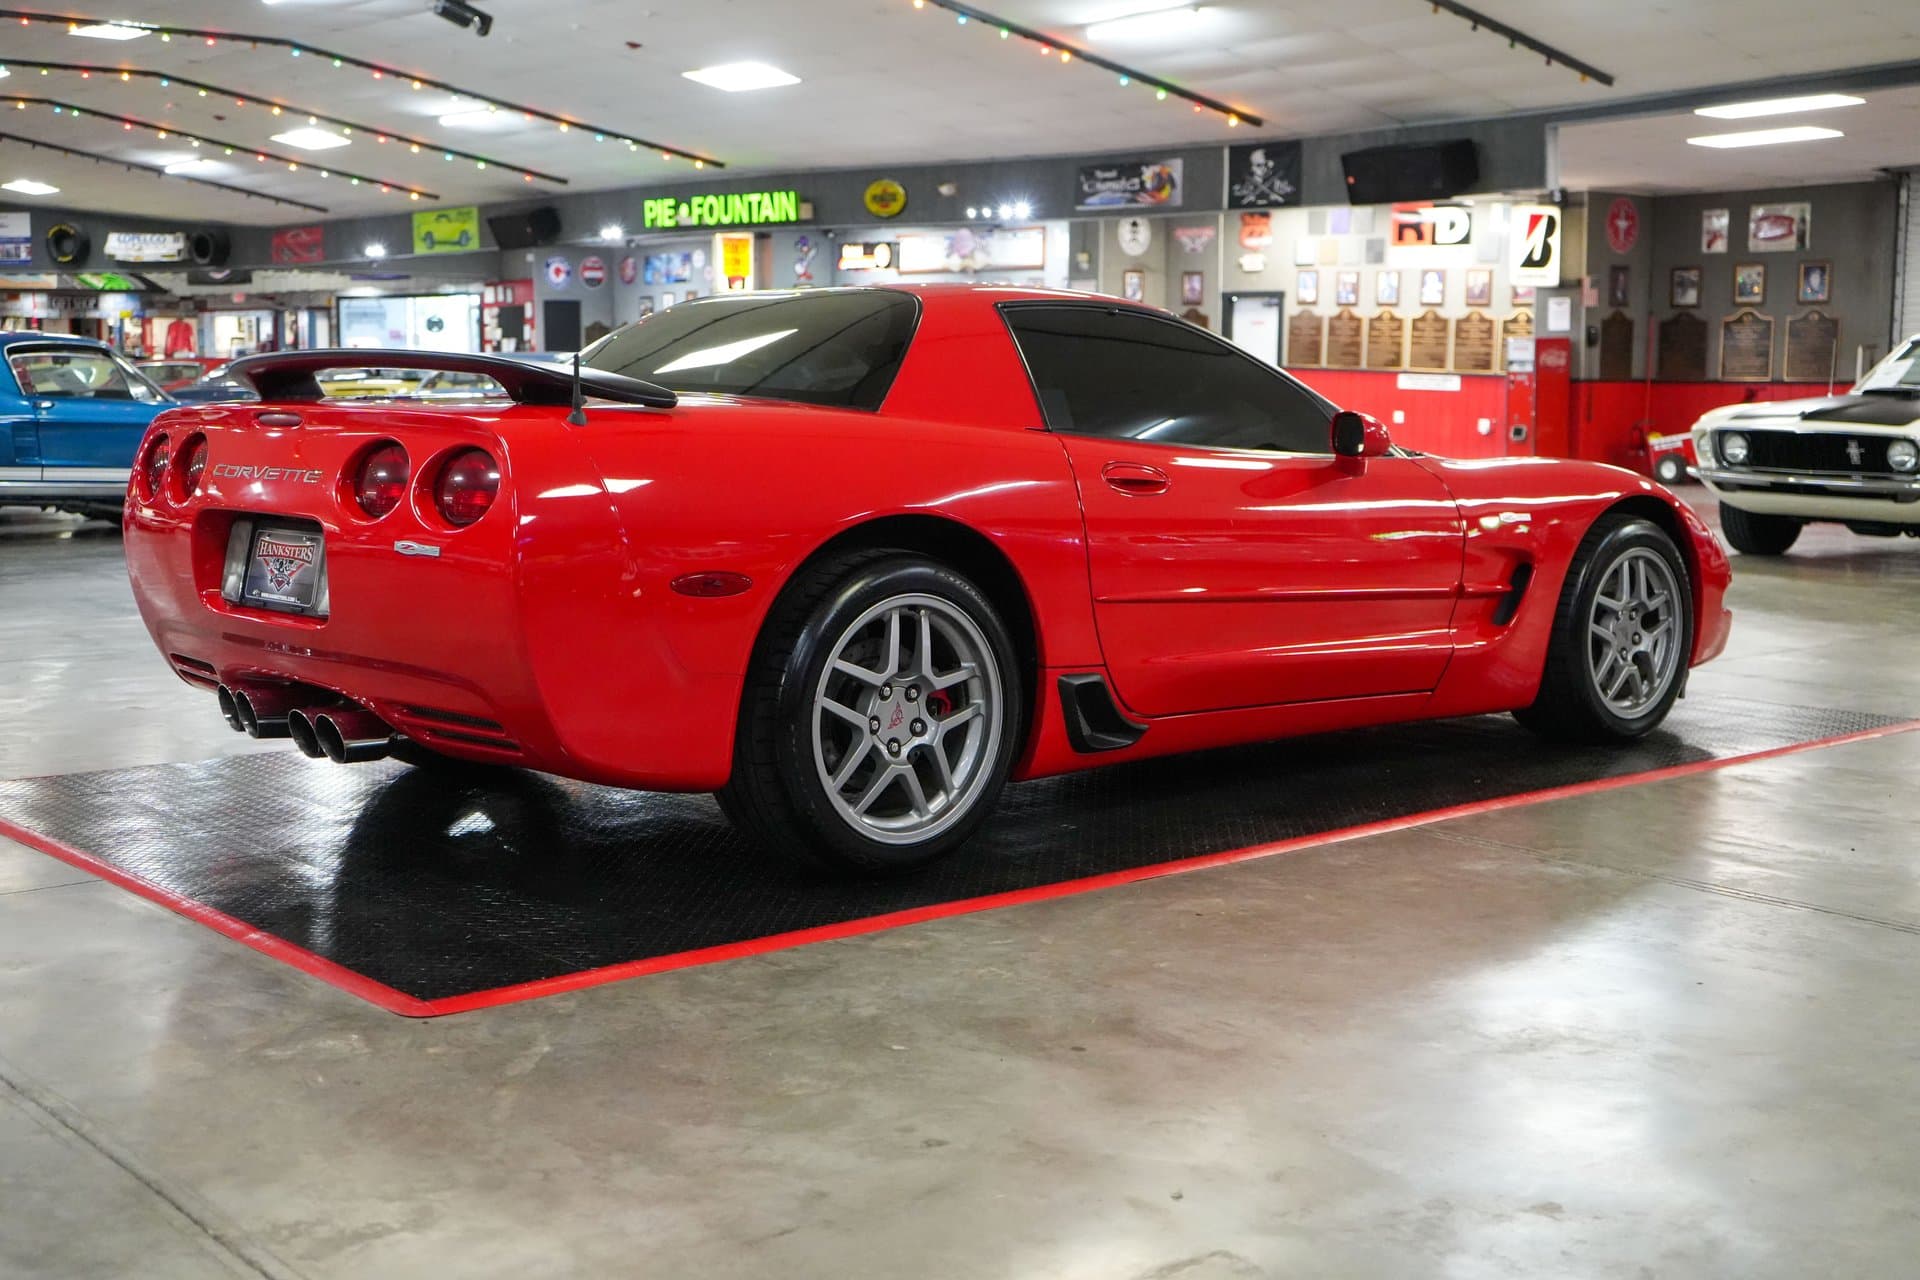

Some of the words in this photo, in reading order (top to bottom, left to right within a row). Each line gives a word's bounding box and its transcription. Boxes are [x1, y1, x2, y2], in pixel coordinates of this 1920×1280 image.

[643, 199, 677, 228] PIE
[690, 190, 797, 226] FOUNTAIN
[212, 463, 324, 483] CORVETTE
[259, 541, 314, 562] HANKSTERS
